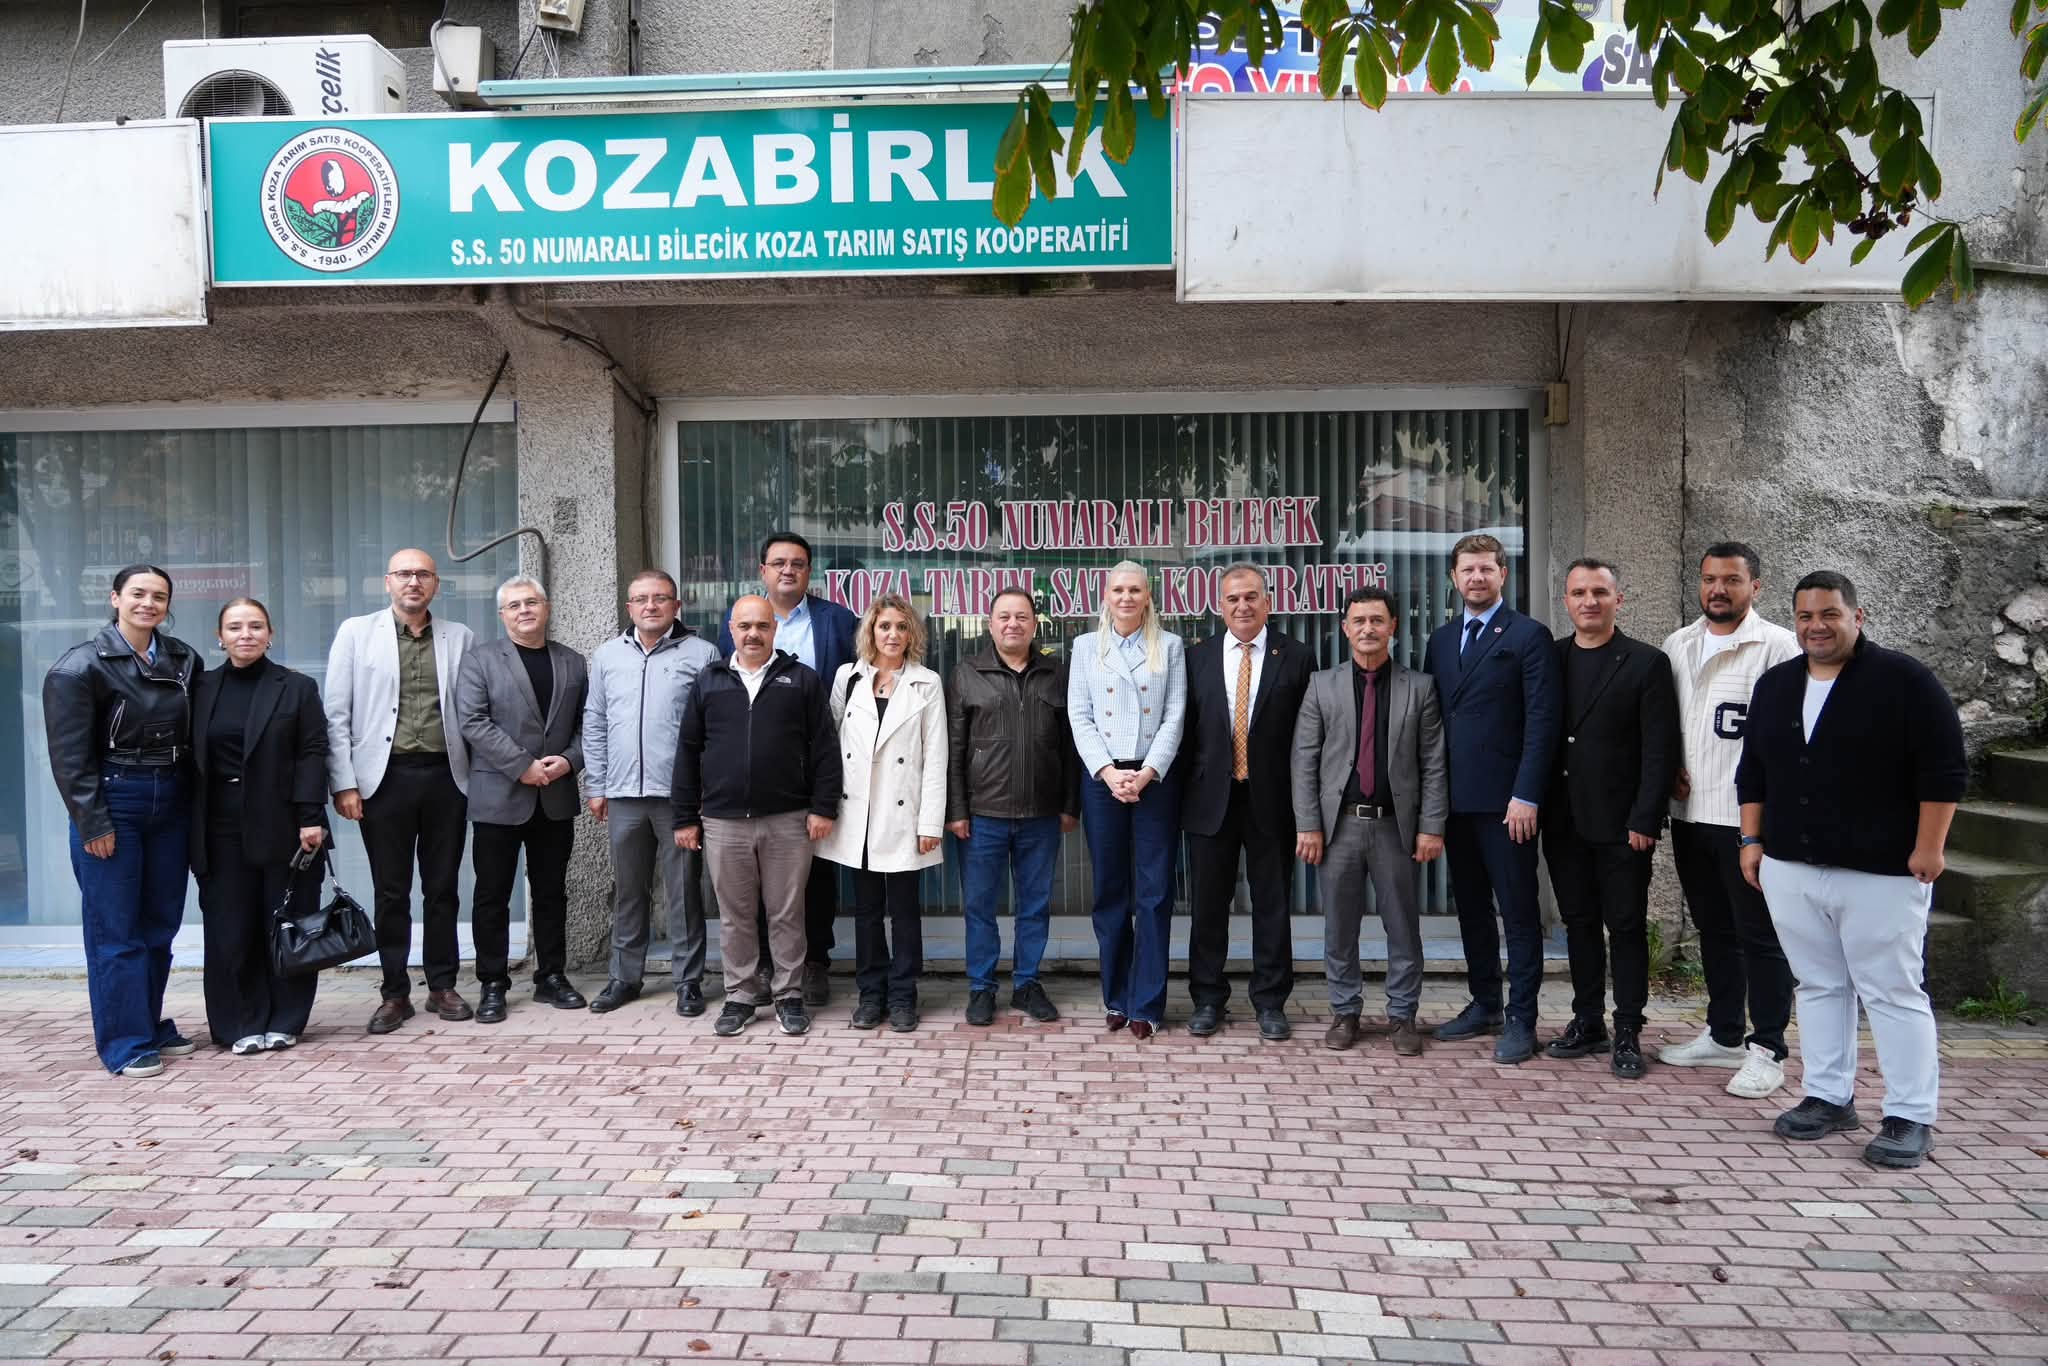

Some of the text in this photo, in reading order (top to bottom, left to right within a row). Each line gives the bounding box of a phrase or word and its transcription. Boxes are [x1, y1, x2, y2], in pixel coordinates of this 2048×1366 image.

[315, 46, 349, 116] çelik
[278, 141, 308, 168] TARIM
[448, 113, 1128, 213] KOZABİRLK
[267, 171, 282, 201] KOZA
[268, 205, 290, 242] BURSA
[451, 217, 1129, 265] S.S. 50 NUMARALI BİLECİK KOZA TARIM SATIŞ KOOPERATİFİ
[1000, 499, 1173, 550] NUMARALI
